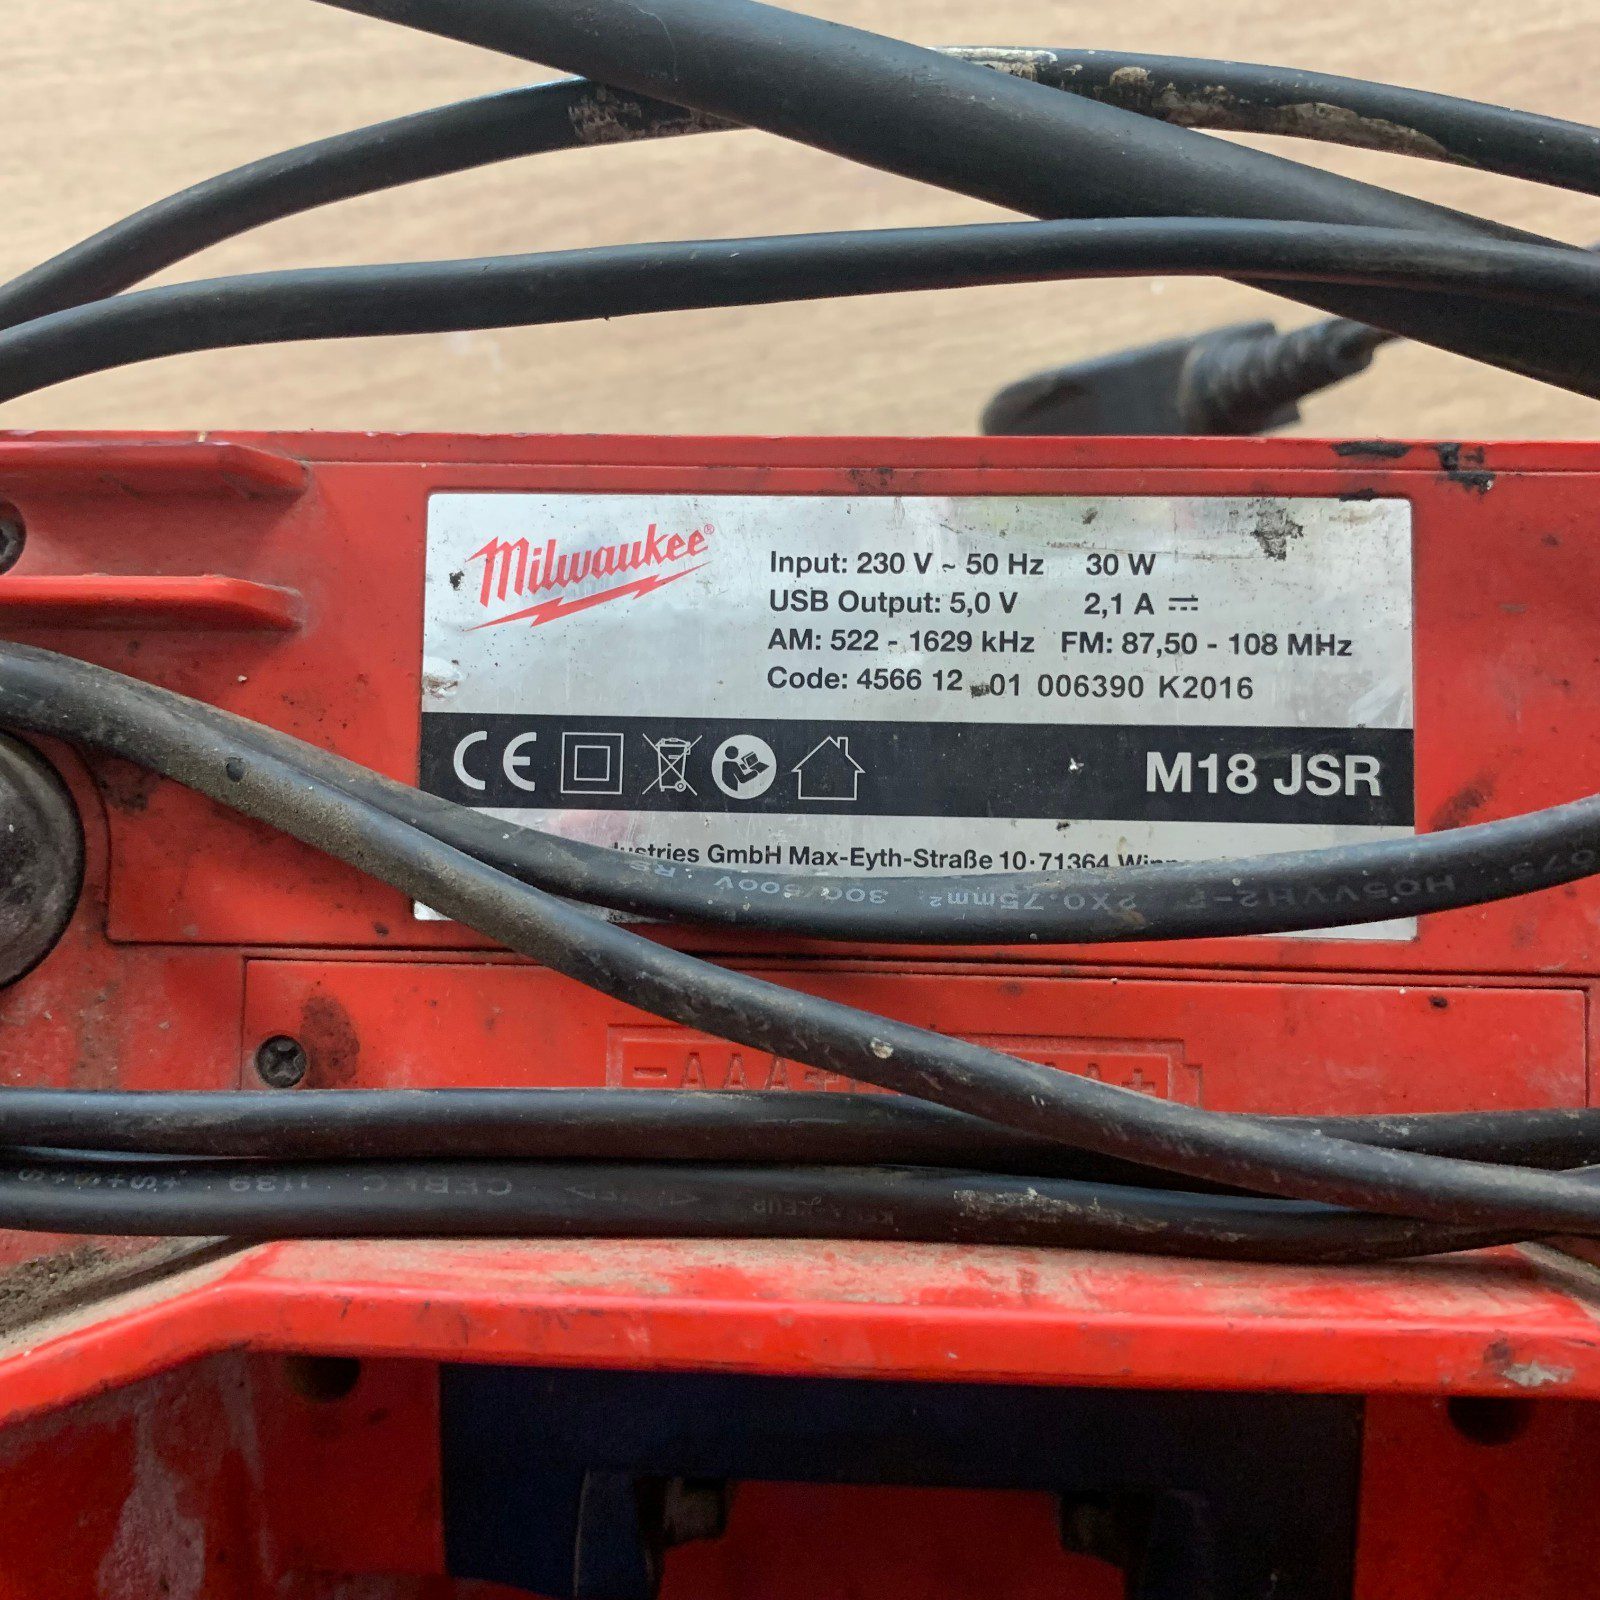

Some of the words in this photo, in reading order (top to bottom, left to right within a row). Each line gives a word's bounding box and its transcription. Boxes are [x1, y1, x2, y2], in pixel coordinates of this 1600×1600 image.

[770, 551, 848, 578] Input:
[857, 552, 905, 574] 230
[914, 553, 933, 574] V
[966, 553, 999, 575] 50
[1008, 554, 1044, 575] Hz
[1086, 553, 1119, 575] 30
[1129, 554, 1156, 575] W
[770, 589, 829, 612] USB
[838, 590, 941, 617] Output:
[949, 592, 991, 617] 5,0
[999, 592, 1018, 613] V
[1084, 593, 1122, 618] 2,1
[1134, 593, 1155, 615] A
[768, 628, 822, 650] AM:
[830, 629, 879, 651] 522
[910, 630, 973, 652] 1629
[982, 631, 1035, 653] kHz
[1061, 632, 1113, 653] FM:
[1121, 632, 1198, 658] 87,50
[1229, 633, 1278, 655] 108
[1287, 633, 1353, 657] MHz
[767, 666, 848, 689] Code:
[857, 668, 922, 690] 4566
[932, 669, 963, 691] 12
[989, 673, 1021, 696] 01
[1037, 674, 1144, 698] 006390
[1158, 675, 1253, 699] K2016
[453, 730, 537, 792] CE
[1146, 751, 1257, 795] M18
[1273, 753, 1381, 796] JSR
[707, 843, 781, 865] GmbH
[789, 846, 993, 871] Max-Eyth-Straße
